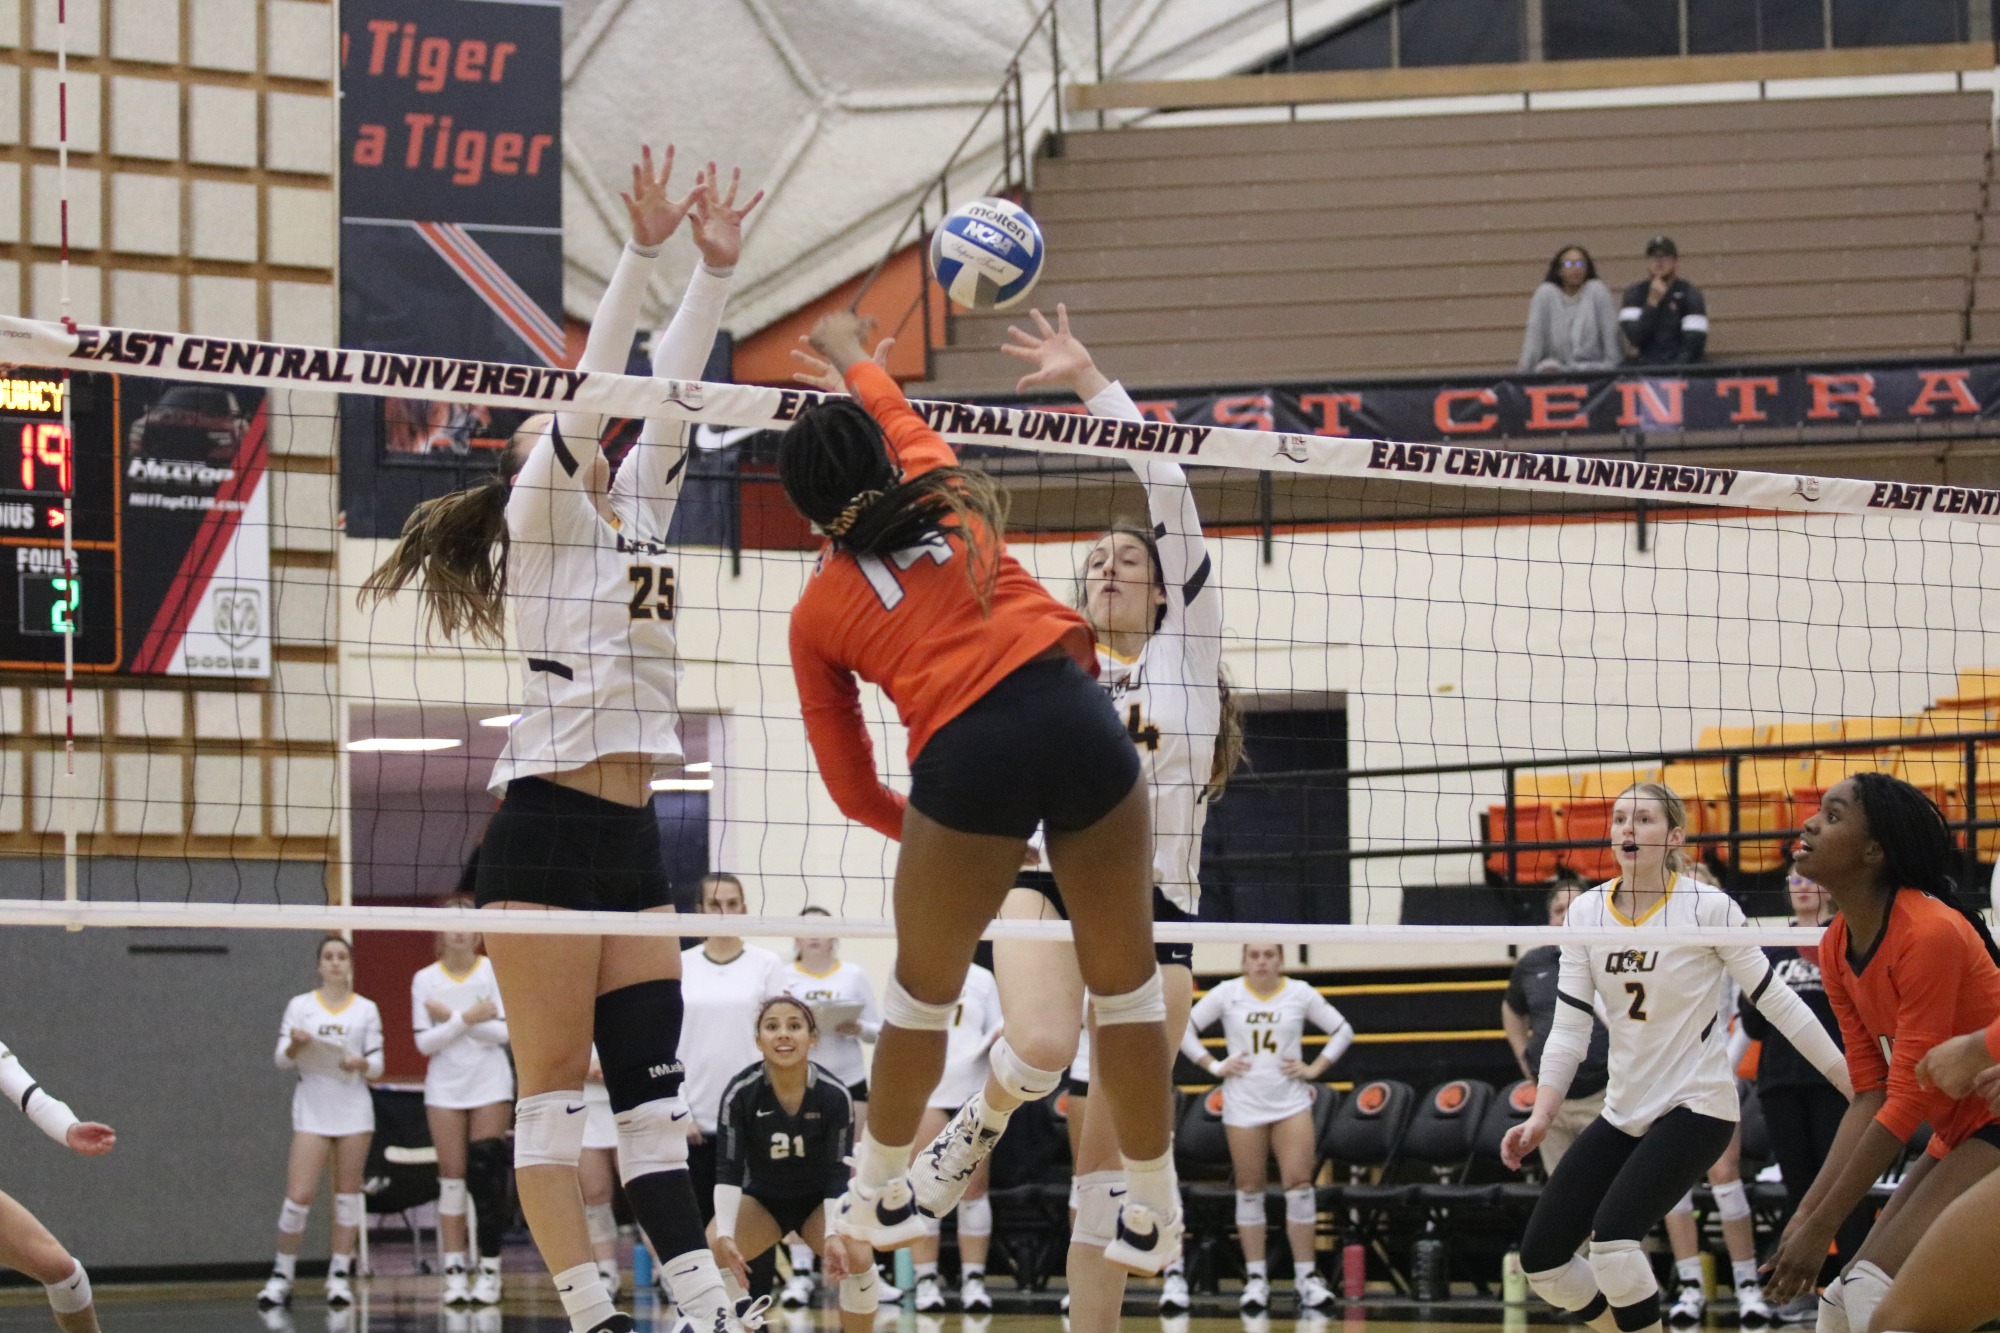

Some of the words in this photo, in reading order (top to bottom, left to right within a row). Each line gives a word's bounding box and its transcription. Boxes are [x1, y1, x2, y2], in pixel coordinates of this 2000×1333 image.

[366, 19, 518, 93] Tiger
[352, 123, 388, 167] a
[404, 112, 553, 186] Tiger
[962, 220, 1014, 257] NCAA
[968, 206, 1026, 242] molten
[68, 329, 174, 367] EAST
[176, 337, 354, 383] CENTRAL
[360, 352, 590, 402] UNIVERSITY
[1433, 370, 1982, 433] CENTRA
[20, 423, 72, 491] 19
[1018, 410, 1212, 456] UNIVERSITY
[1366, 440, 1443, 473] EAST
[1444, 447, 1572, 483] CENTRAL
[1575, 458, 1739, 496] UNIVERSITY
[1866, 482, 1933, 511] EAST
[17, 547, 79, 574] FOULS
[51, 578, 80, 633] 2
[627, 565, 675, 621] 25
[1126, 702, 1160, 752] 4
[1623, 981, 1648, 1022] 2
[1252, 1029, 1277, 1055] 14
[769, 1131, 806, 1160] 21
